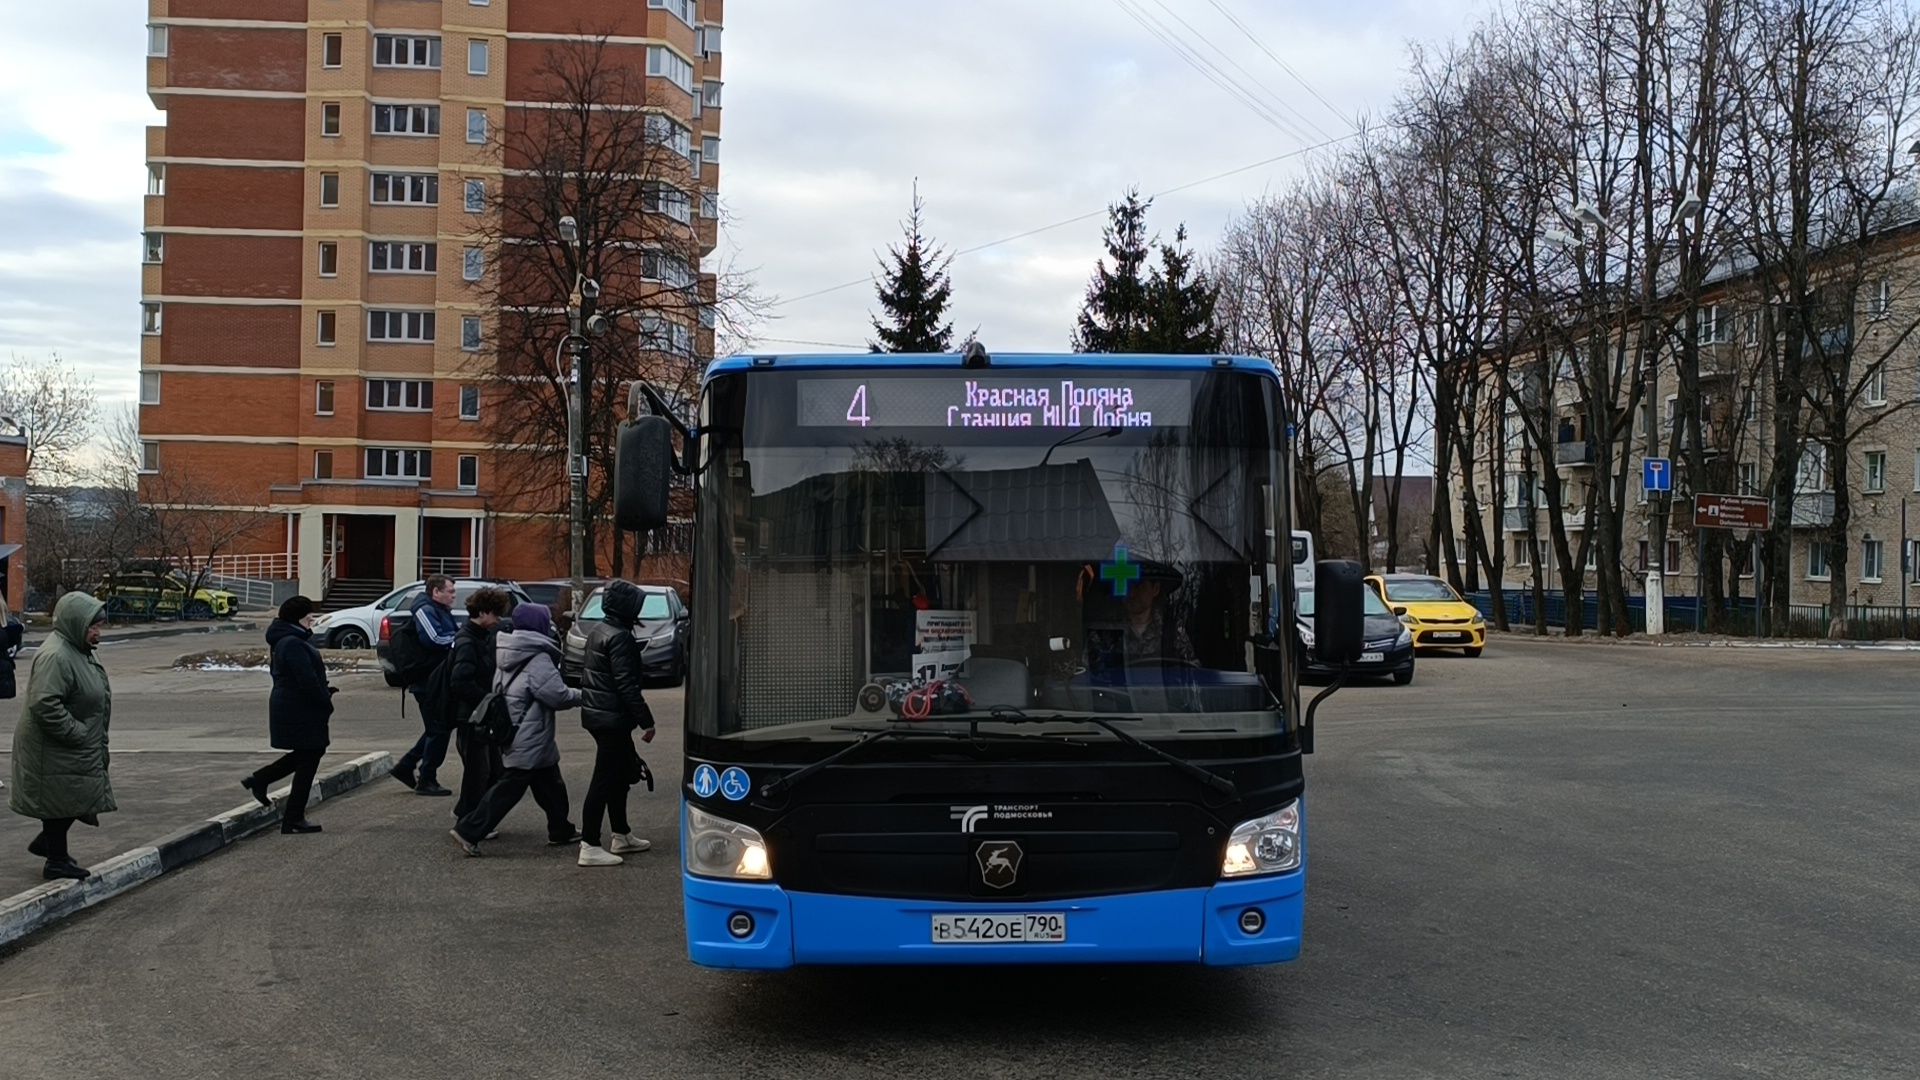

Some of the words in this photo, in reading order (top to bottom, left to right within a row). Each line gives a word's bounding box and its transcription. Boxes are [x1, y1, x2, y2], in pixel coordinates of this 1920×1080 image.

[846, 384, 871, 427] 4
[965, 381, 1050, 407] Красная
[1061, 381, 1134, 407] Поляна
[947, 406, 1032, 427] Станция
[1027, 916, 1059, 932] 790
